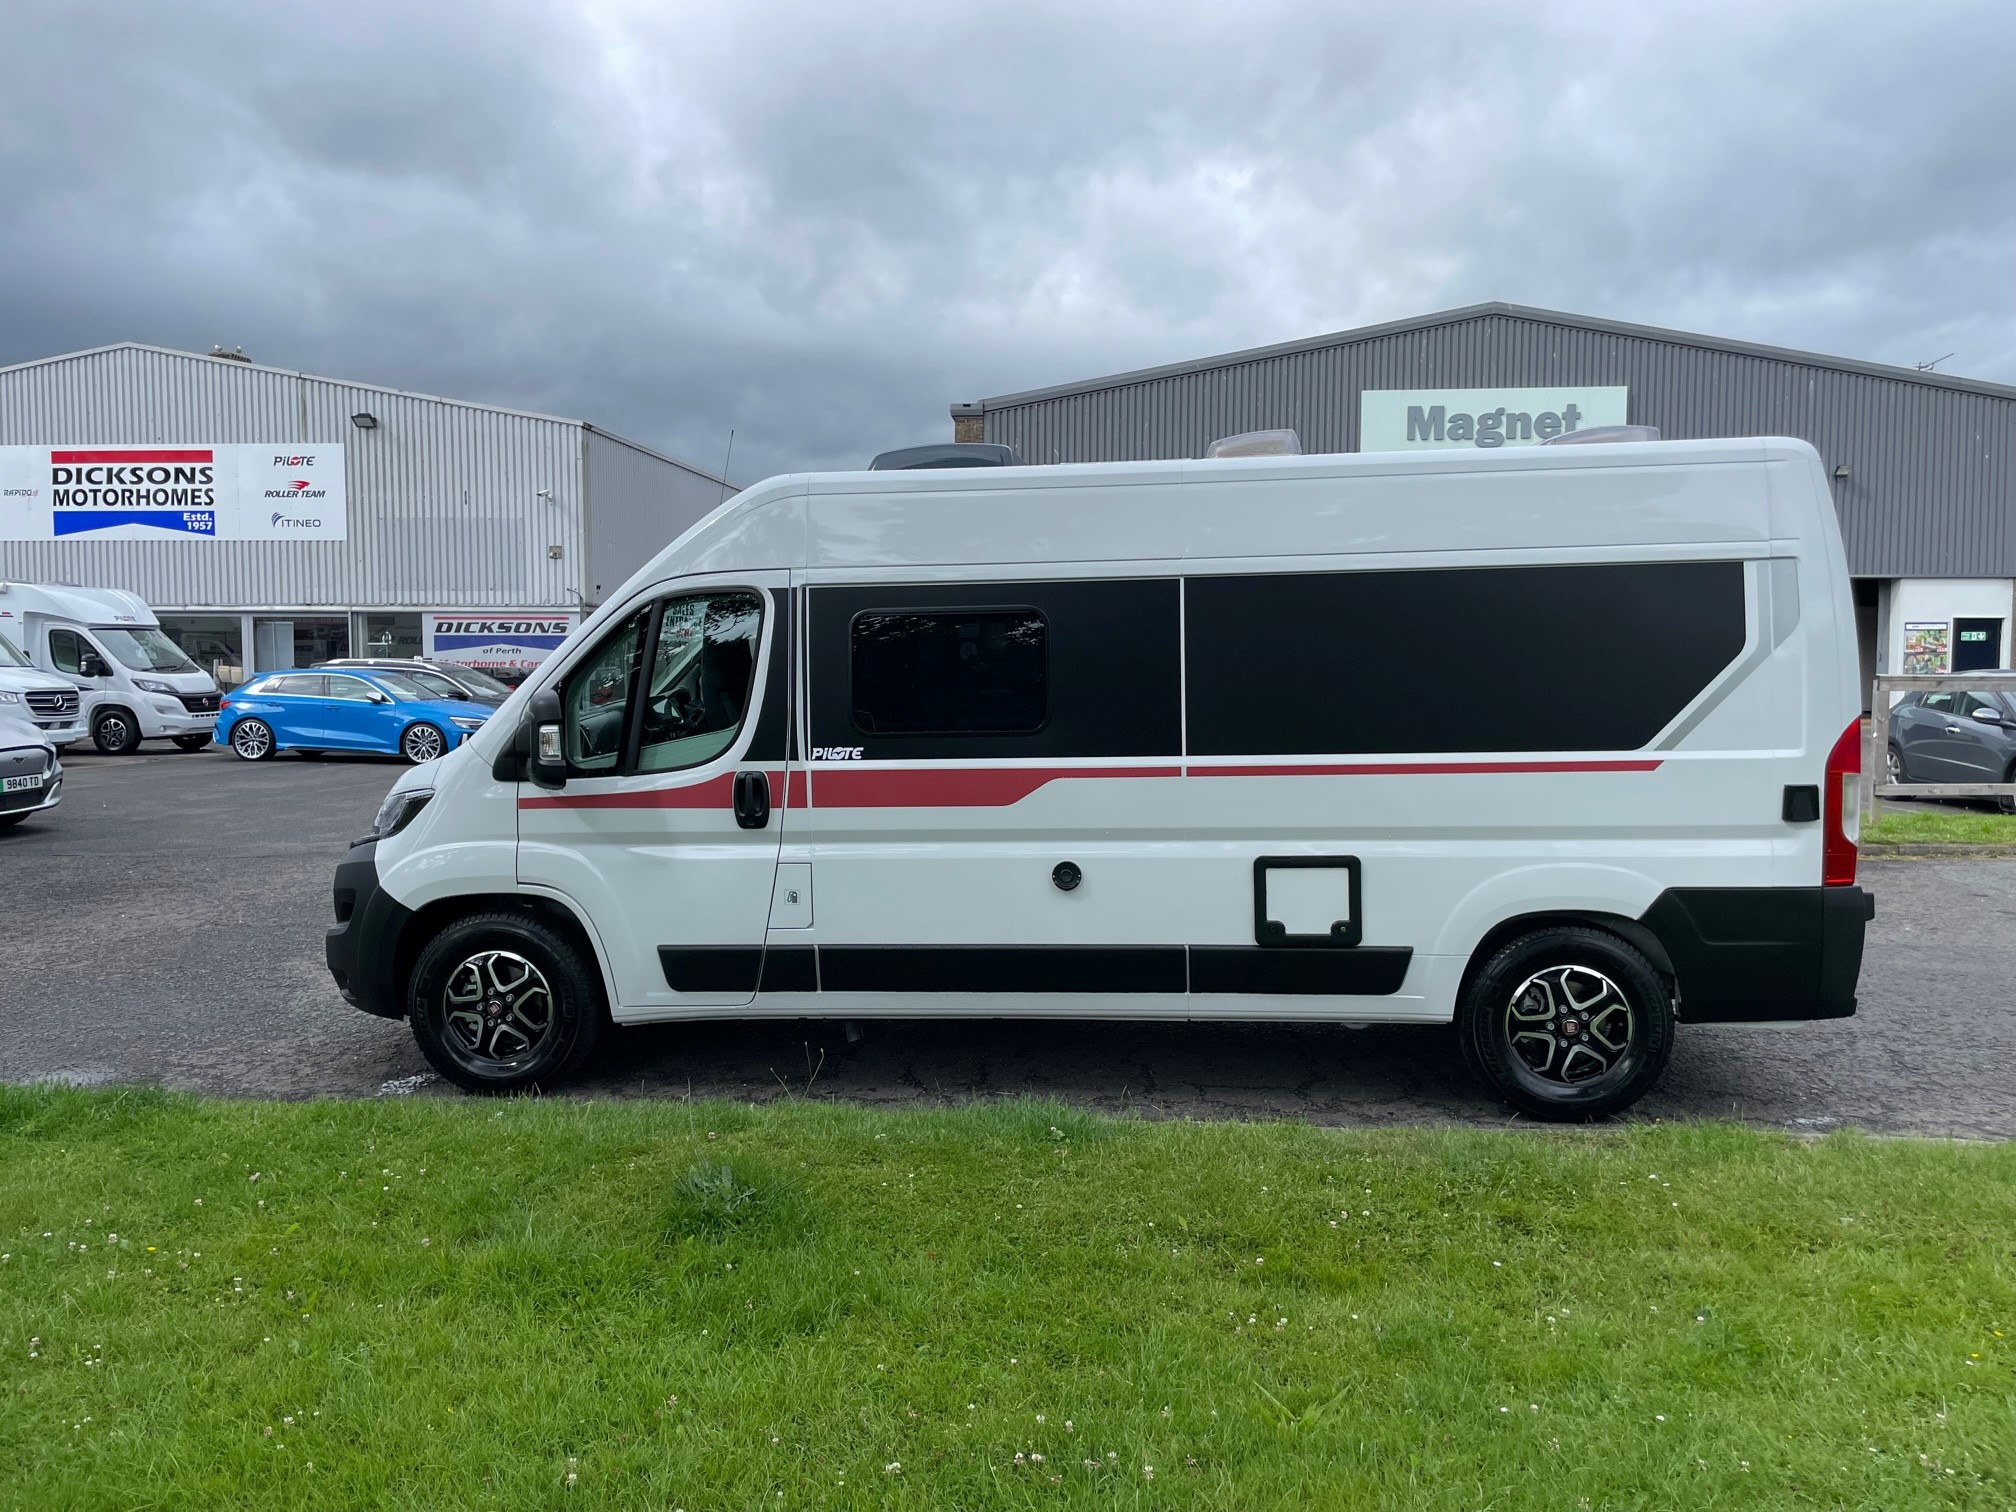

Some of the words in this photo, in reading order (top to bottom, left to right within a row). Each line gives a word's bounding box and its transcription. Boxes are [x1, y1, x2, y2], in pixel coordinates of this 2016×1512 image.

[1406, 403, 1582, 448] Magnet
[52, 466, 214, 485] DICKSONS
[52, 488, 215, 507] MOTORHOMES
[264, 490, 299, 498] ROLLER
[300, 490, 326, 498] TEAM
[183, 512, 213, 522] Estd.
[187, 521, 213, 531] 1957
[281, 519, 322, 528] ITINEO
[434, 621, 570, 634] DICKSONS
[482, 647, 493, 655] of
[495, 647, 522, 655] Perth
[508, 659, 517, 668] &
[6, 777, 28, 790] 9840
[29, 776, 39, 787] TD
